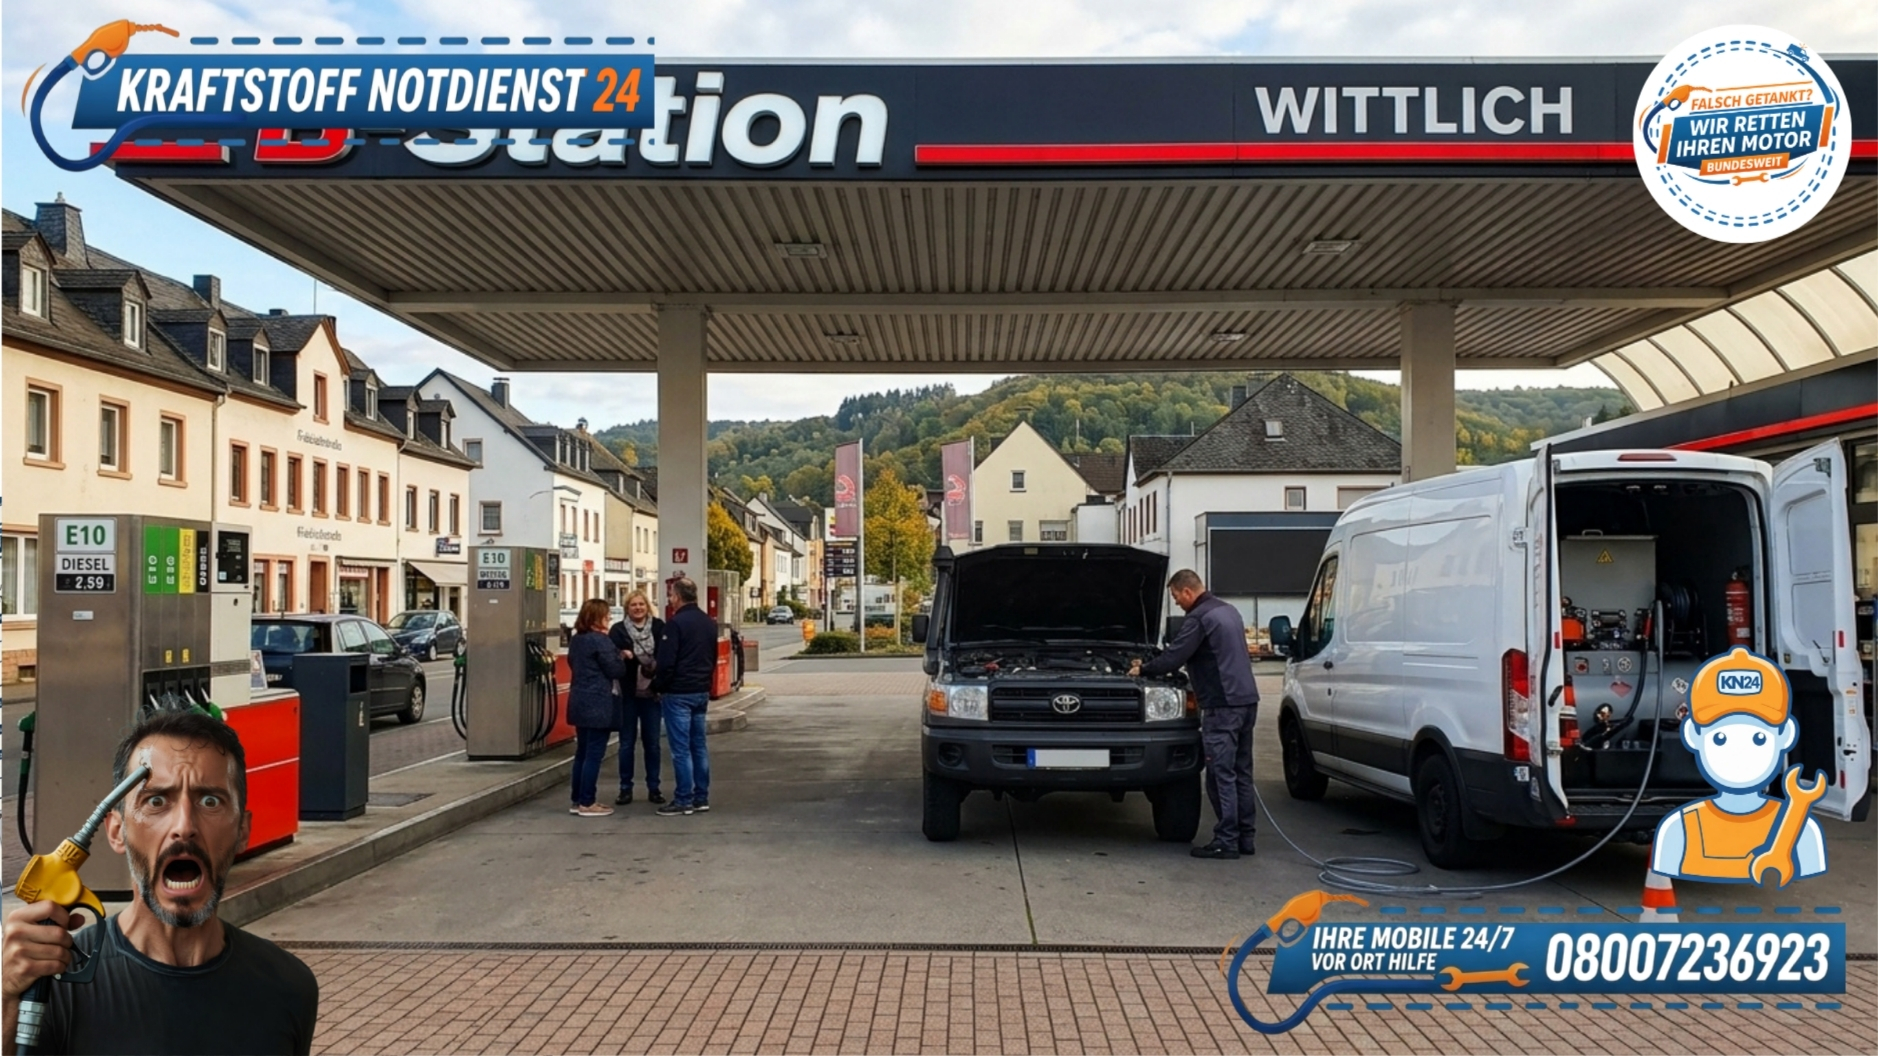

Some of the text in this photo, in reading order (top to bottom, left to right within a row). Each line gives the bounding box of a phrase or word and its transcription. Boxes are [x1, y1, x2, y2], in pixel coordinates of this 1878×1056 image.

[1254, 86, 1573, 135] WITTLICH
[66, 525, 106, 545] E10
[62, 558, 110, 571] DIESEL
